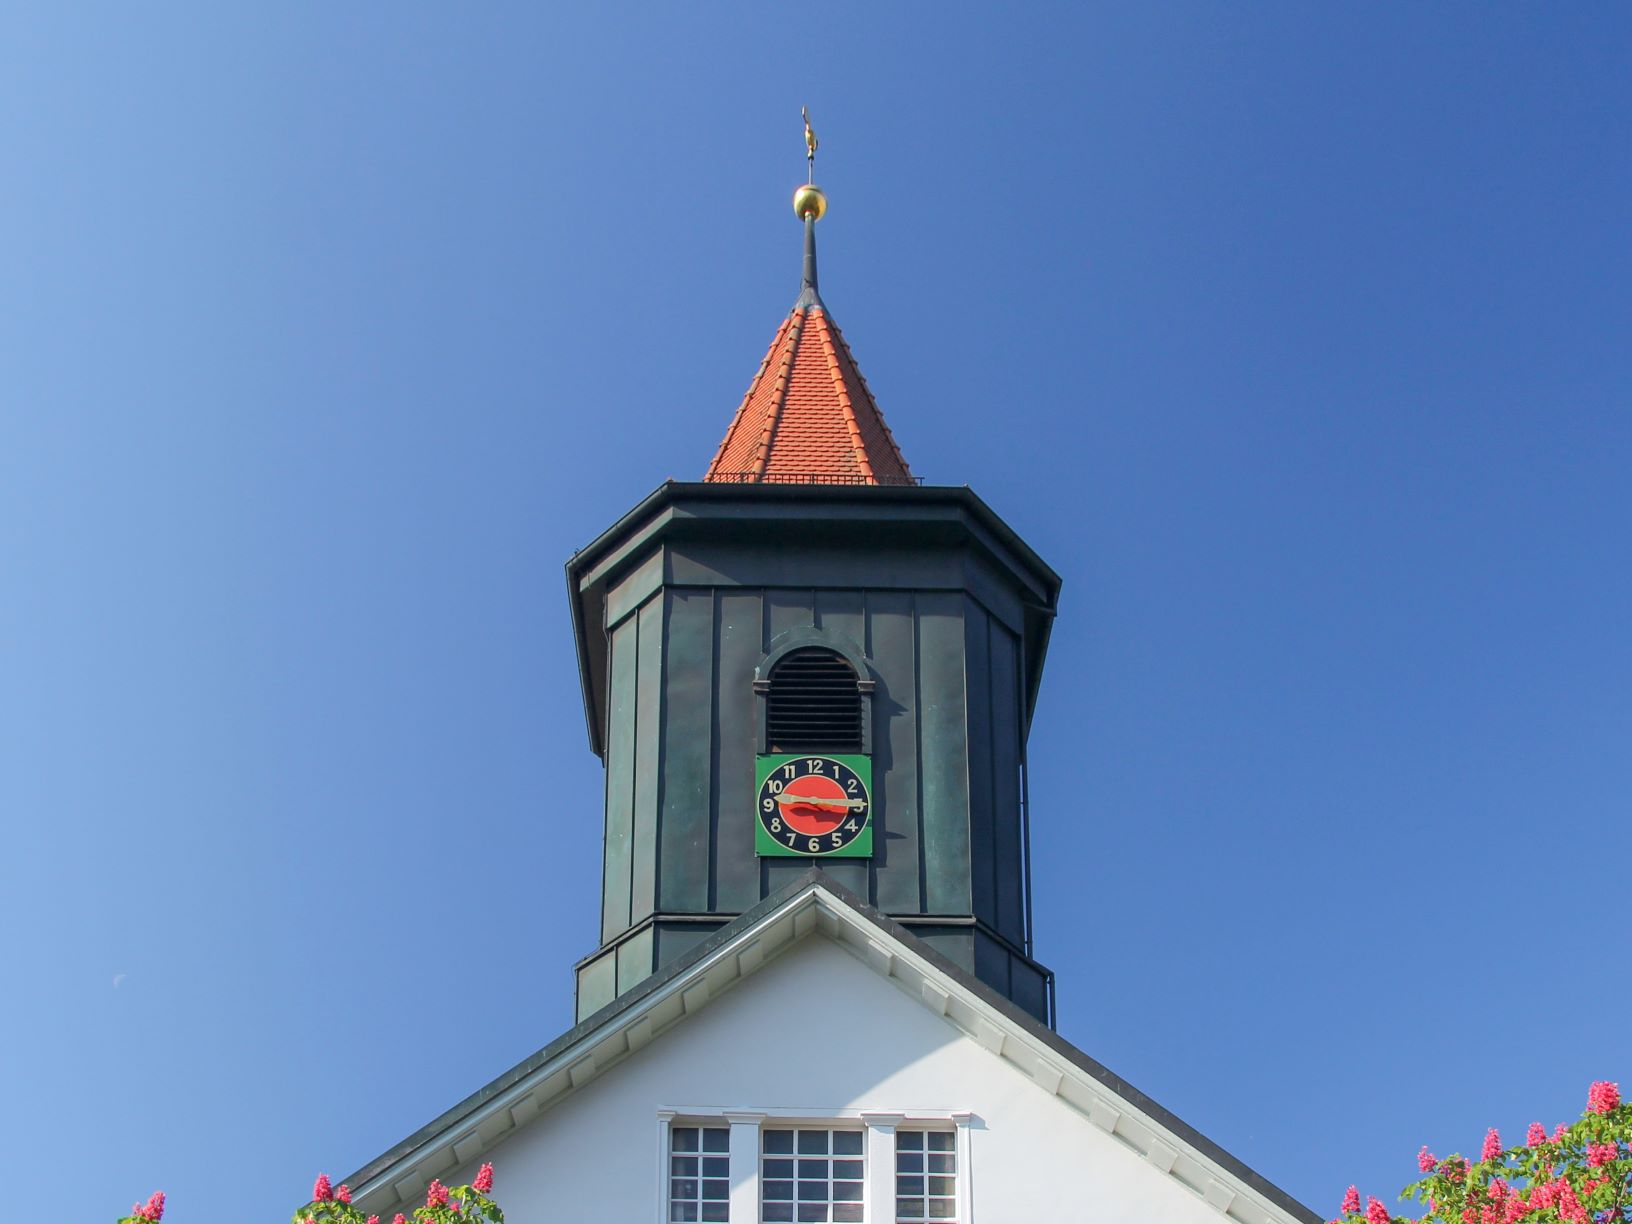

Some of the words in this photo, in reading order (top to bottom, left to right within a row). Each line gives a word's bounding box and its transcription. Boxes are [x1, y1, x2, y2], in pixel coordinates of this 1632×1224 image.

[783, 765, 796, 779] 11
[806, 759, 824, 773] 12
[833, 765, 840, 779] 1
[767, 779, 783, 794] 10
[847, 779, 858, 793] 2
[763, 798, 775, 812] 9
[770, 817, 782, 832] 8
[844, 818, 859, 832] 4
[786, 833, 797, 847] 7
[808, 838, 820, 852] 6
[831, 832, 842, 847] 5
